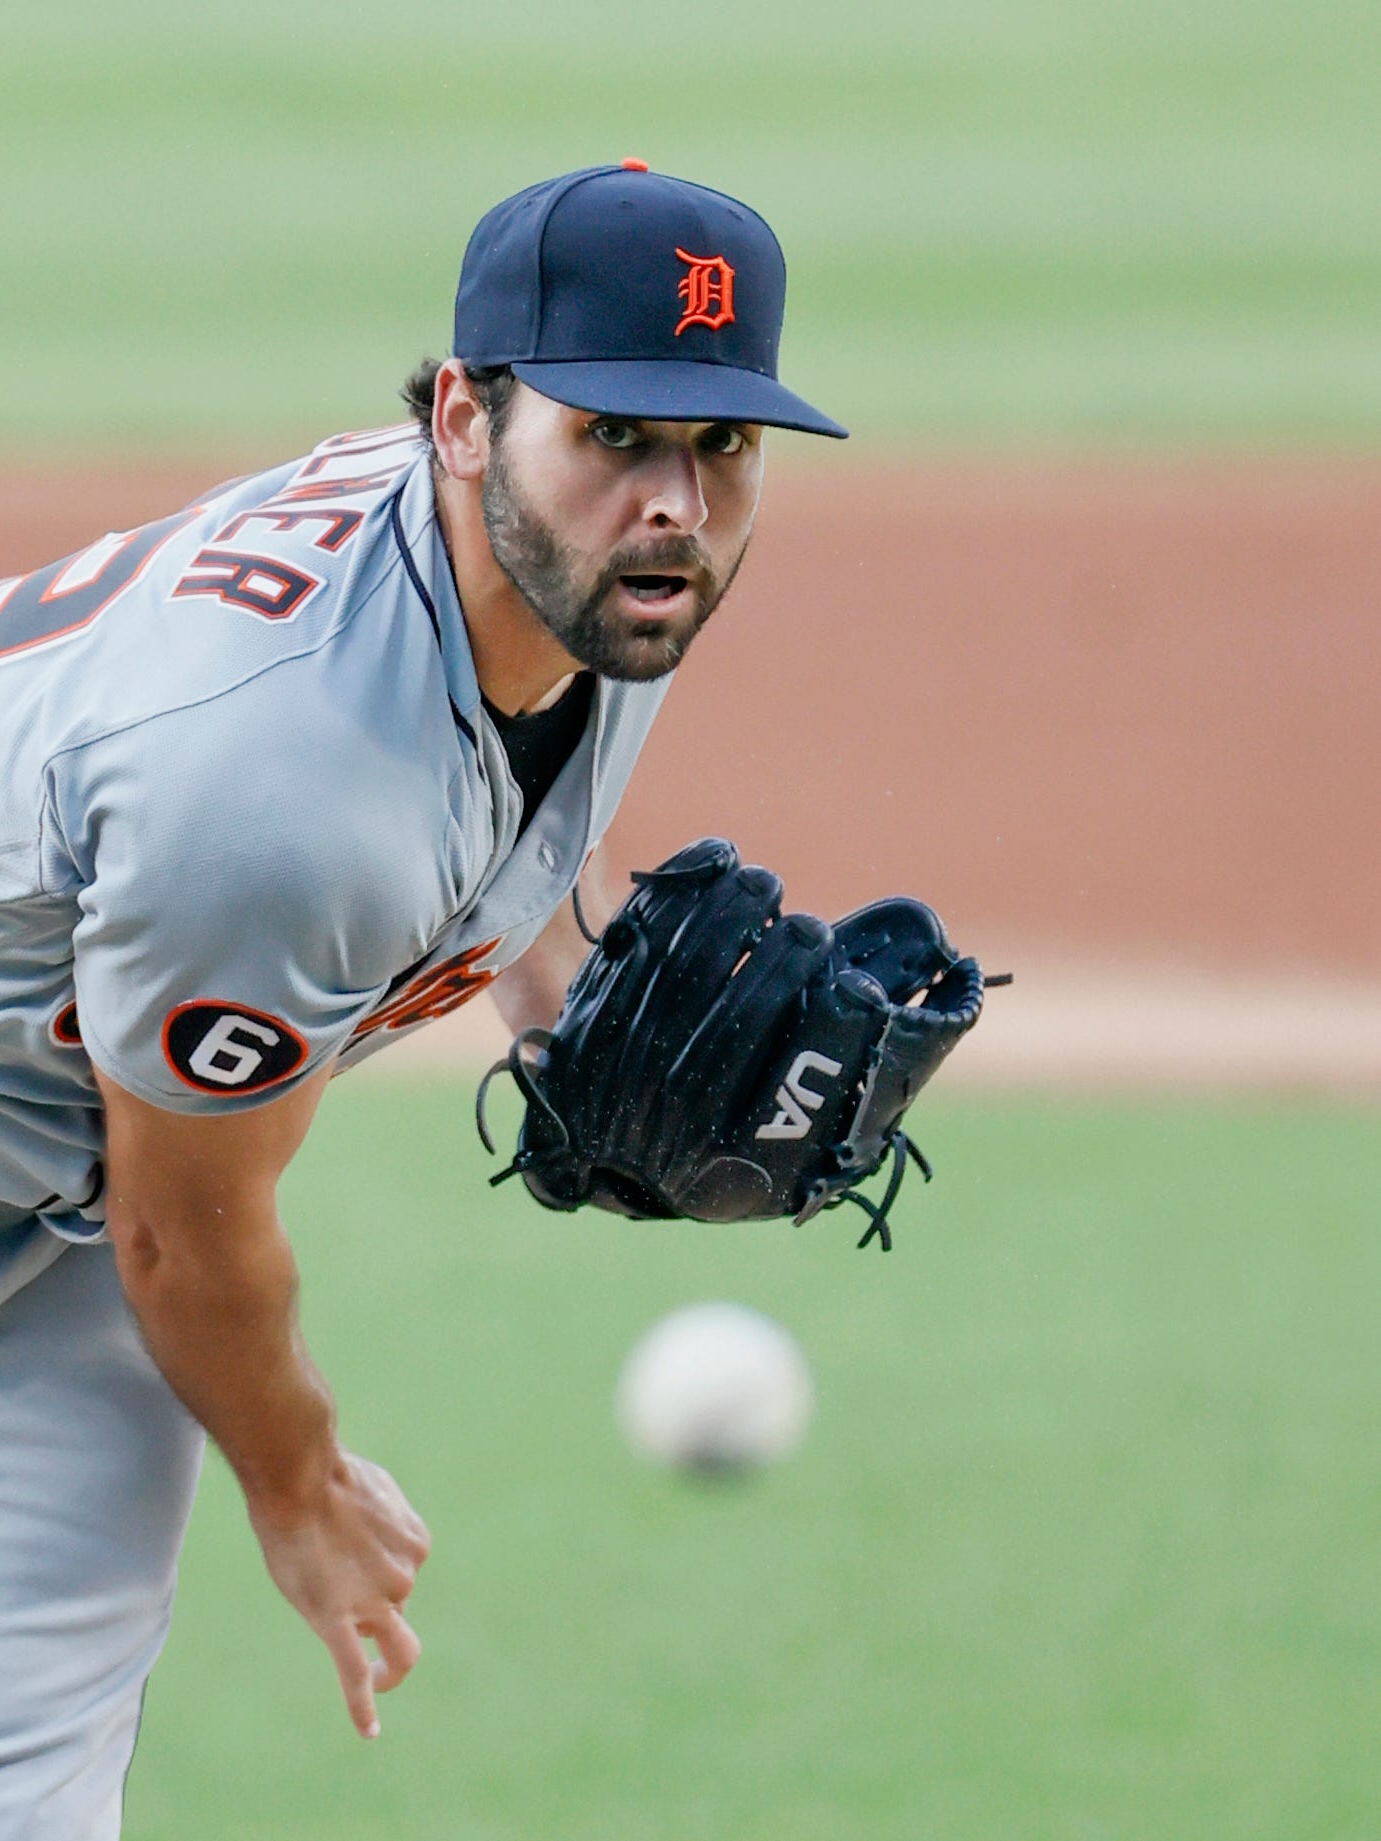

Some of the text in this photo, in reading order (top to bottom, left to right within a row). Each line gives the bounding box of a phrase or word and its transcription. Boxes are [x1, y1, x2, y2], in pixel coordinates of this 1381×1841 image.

[674, 246, 736, 337] D
[188, 1014, 281, 1085] 6
[754, 1050, 843, 1140] UA
